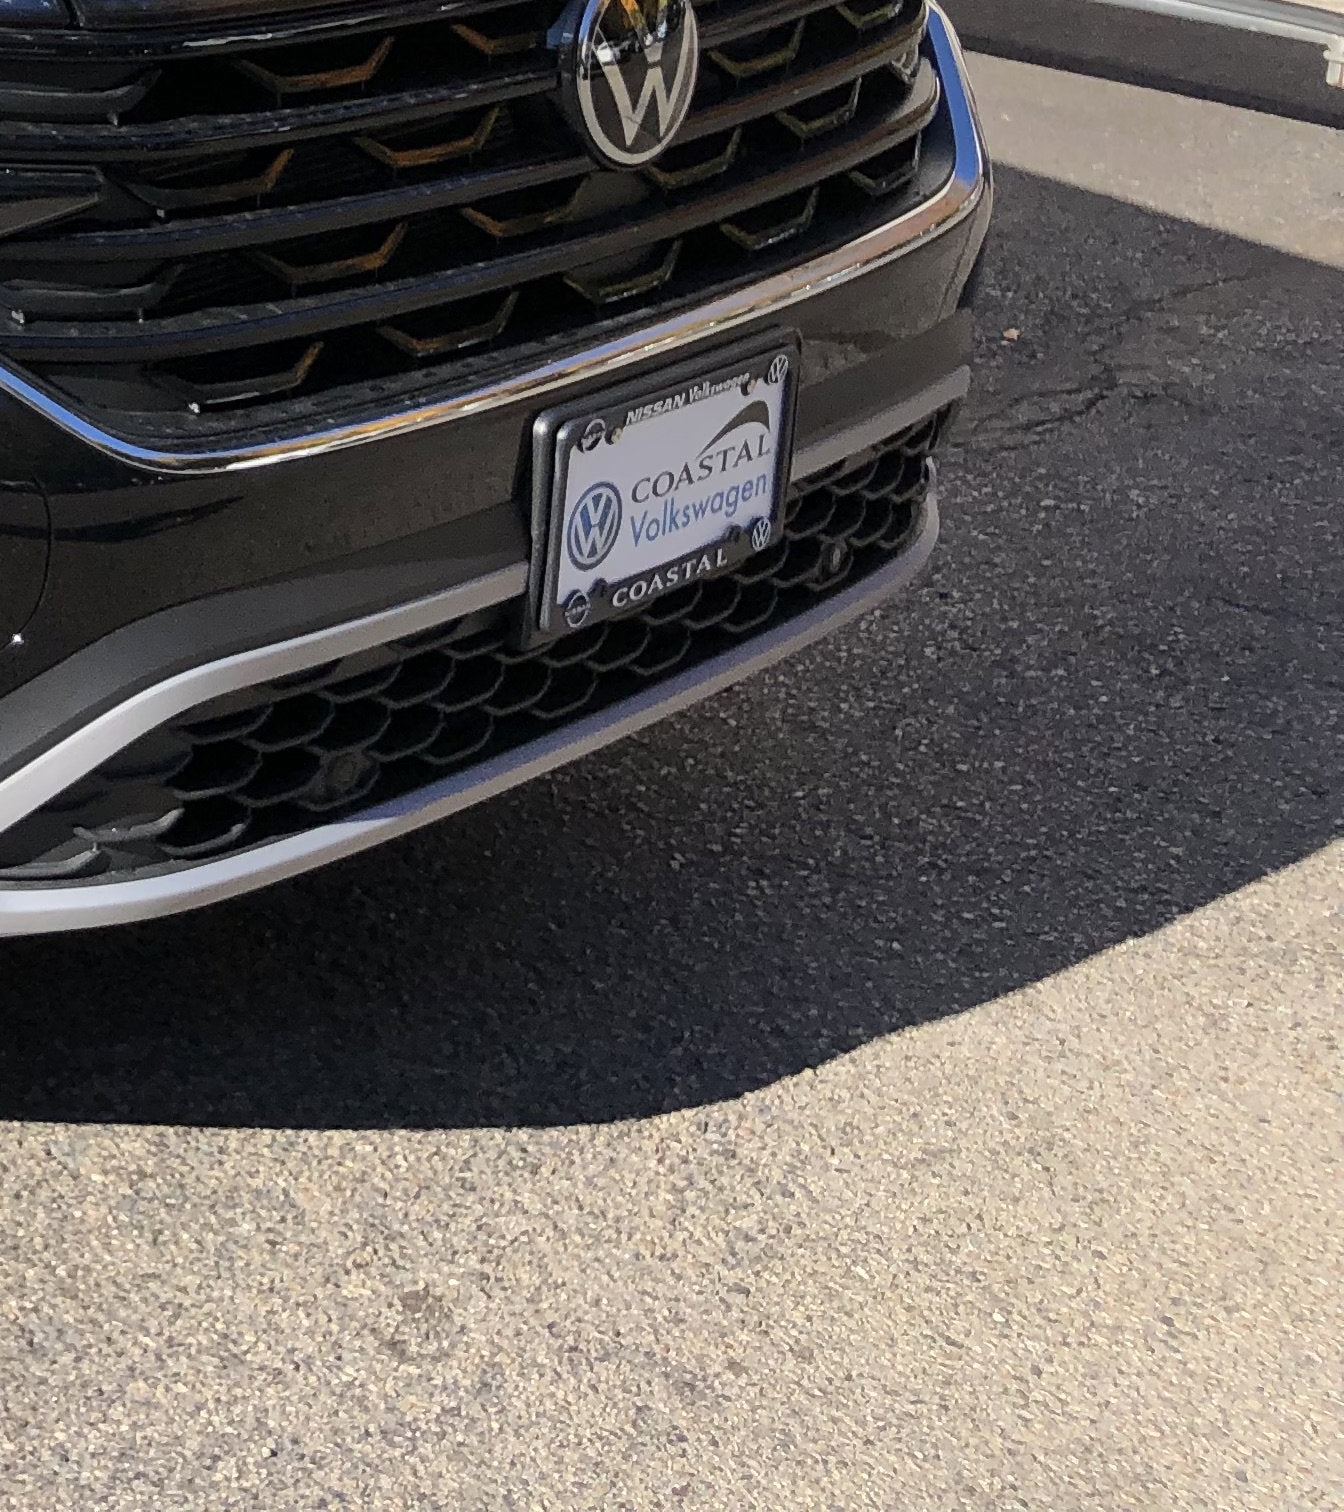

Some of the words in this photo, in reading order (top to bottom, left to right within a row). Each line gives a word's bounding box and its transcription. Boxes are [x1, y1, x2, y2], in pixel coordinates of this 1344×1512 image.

[625, 392, 686, 426] NISSAN
[631, 433, 772, 504] COASTAL
[630, 472, 767, 548] Volkswagen
[612, 548, 728, 608] COASTAL
